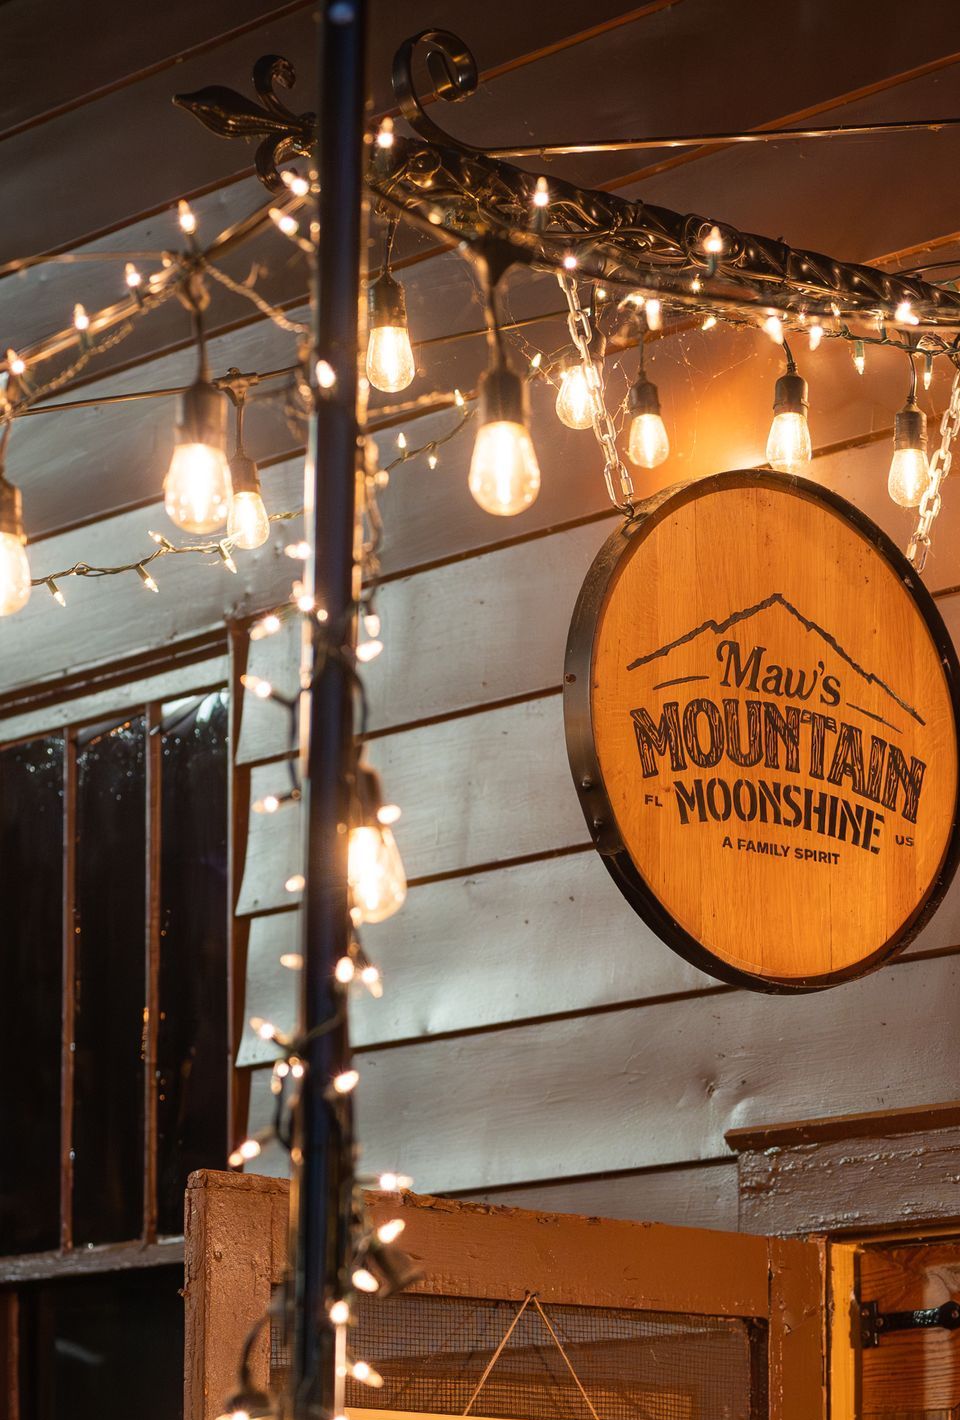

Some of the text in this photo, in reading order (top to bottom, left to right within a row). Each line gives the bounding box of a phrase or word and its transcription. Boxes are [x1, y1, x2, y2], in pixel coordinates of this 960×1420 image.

[716, 640, 841, 706] Maw's
[630, 698, 926, 824] MOUNTAIN
[644, 795, 662, 807] FL
[674, 778, 884, 854] MOONSHINE
[722, 837, 840, 864] A FAMILY SPIRIT
[896, 835, 914, 847] US
